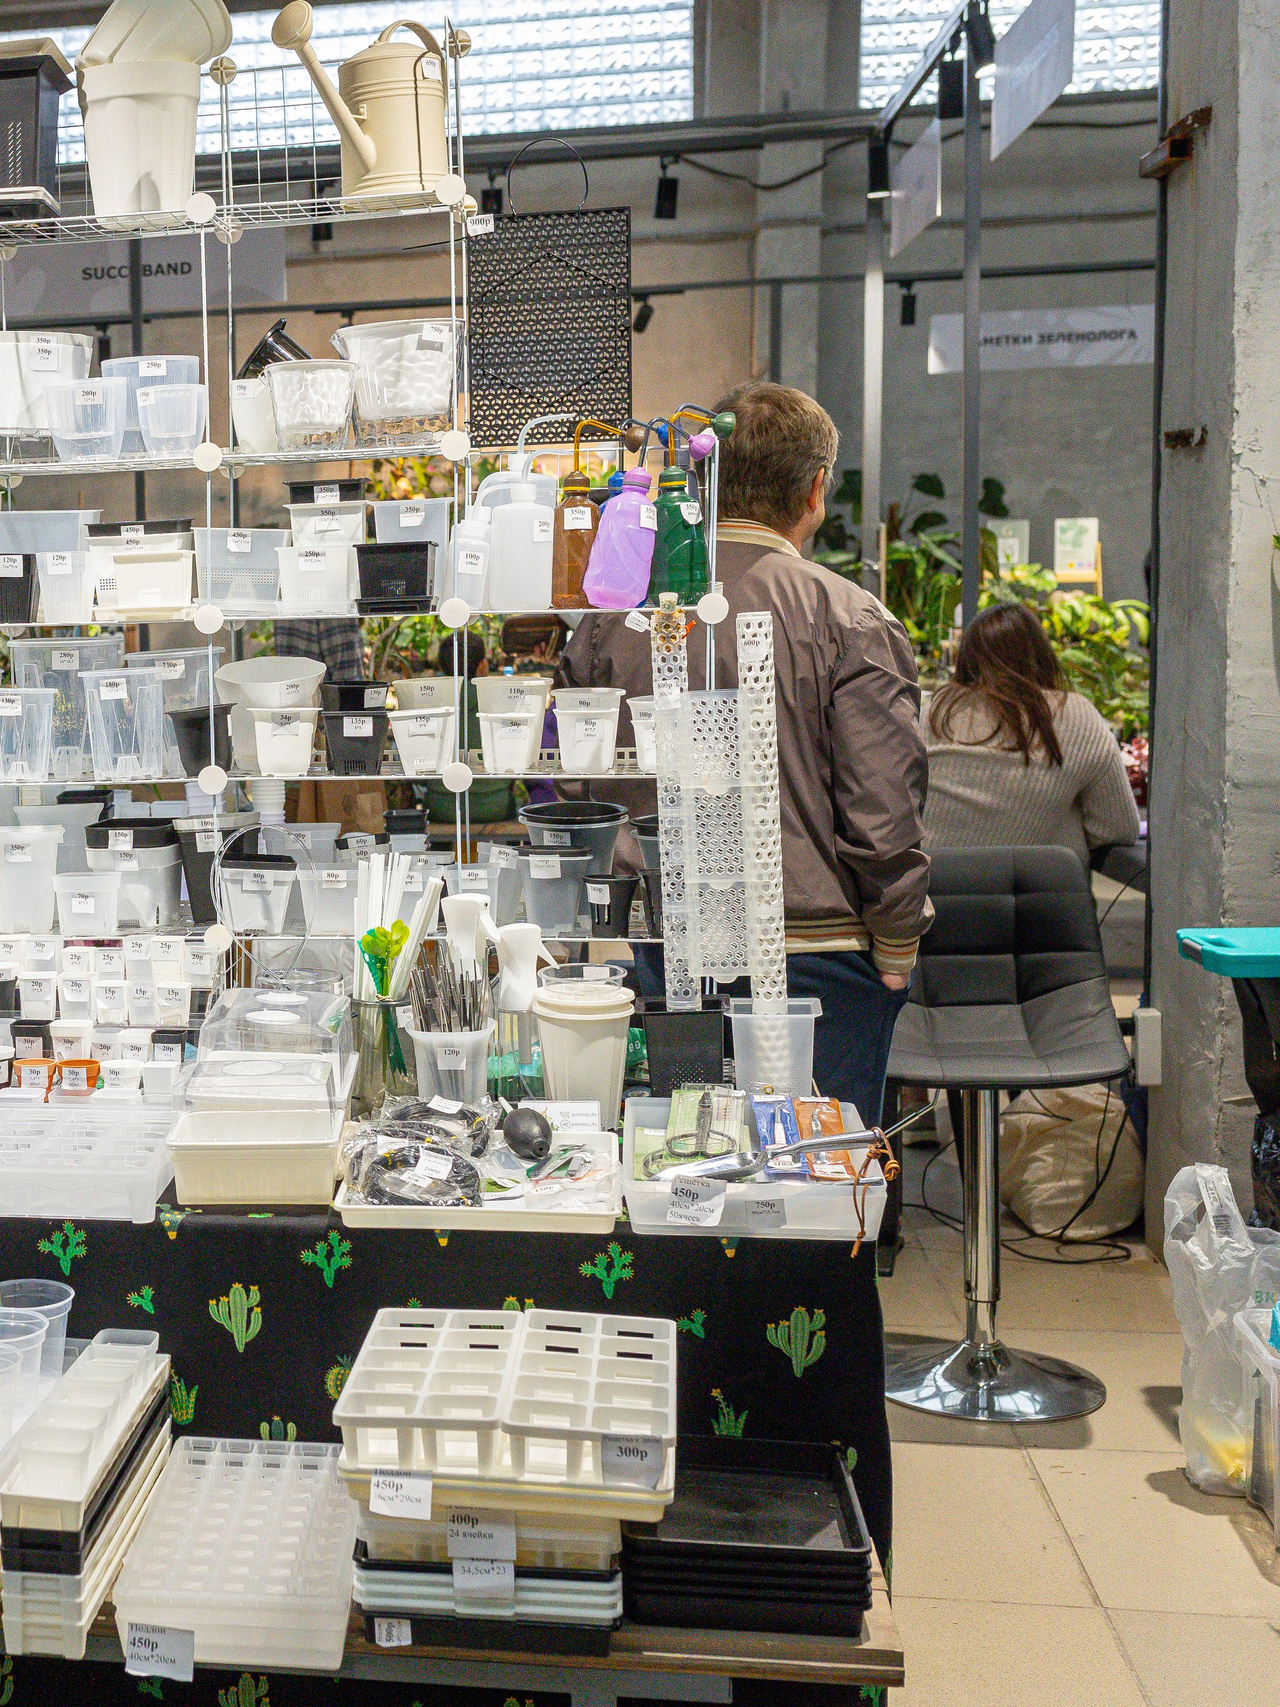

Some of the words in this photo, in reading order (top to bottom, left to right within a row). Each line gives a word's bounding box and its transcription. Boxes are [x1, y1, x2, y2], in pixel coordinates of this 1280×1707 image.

[82, 261, 192, 280] SUCCBAND
[981, 335, 1032, 347] МЕТКИ
[570, 508, 586, 516] 350р
[465, 553, 480, 561] 100р
[743, 640, 760, 648] 600р
[584, 720, 597, 728] 80р
[466, 871, 479, 879] 40р
[443, 1049, 460, 1057] 120р
[672, 1188, 699, 1200] 450р
[755, 1201, 775, 1209] 750р
[616, 1447, 648, 1460] 300р
[373, 1480, 403, 1492] 450р
[449, 1514, 479, 1528] 400р
[449, 1529, 461, 1538] 24
[463, 1531, 493, 1540] ячейки
[130, 1637, 158, 1651] 450р
